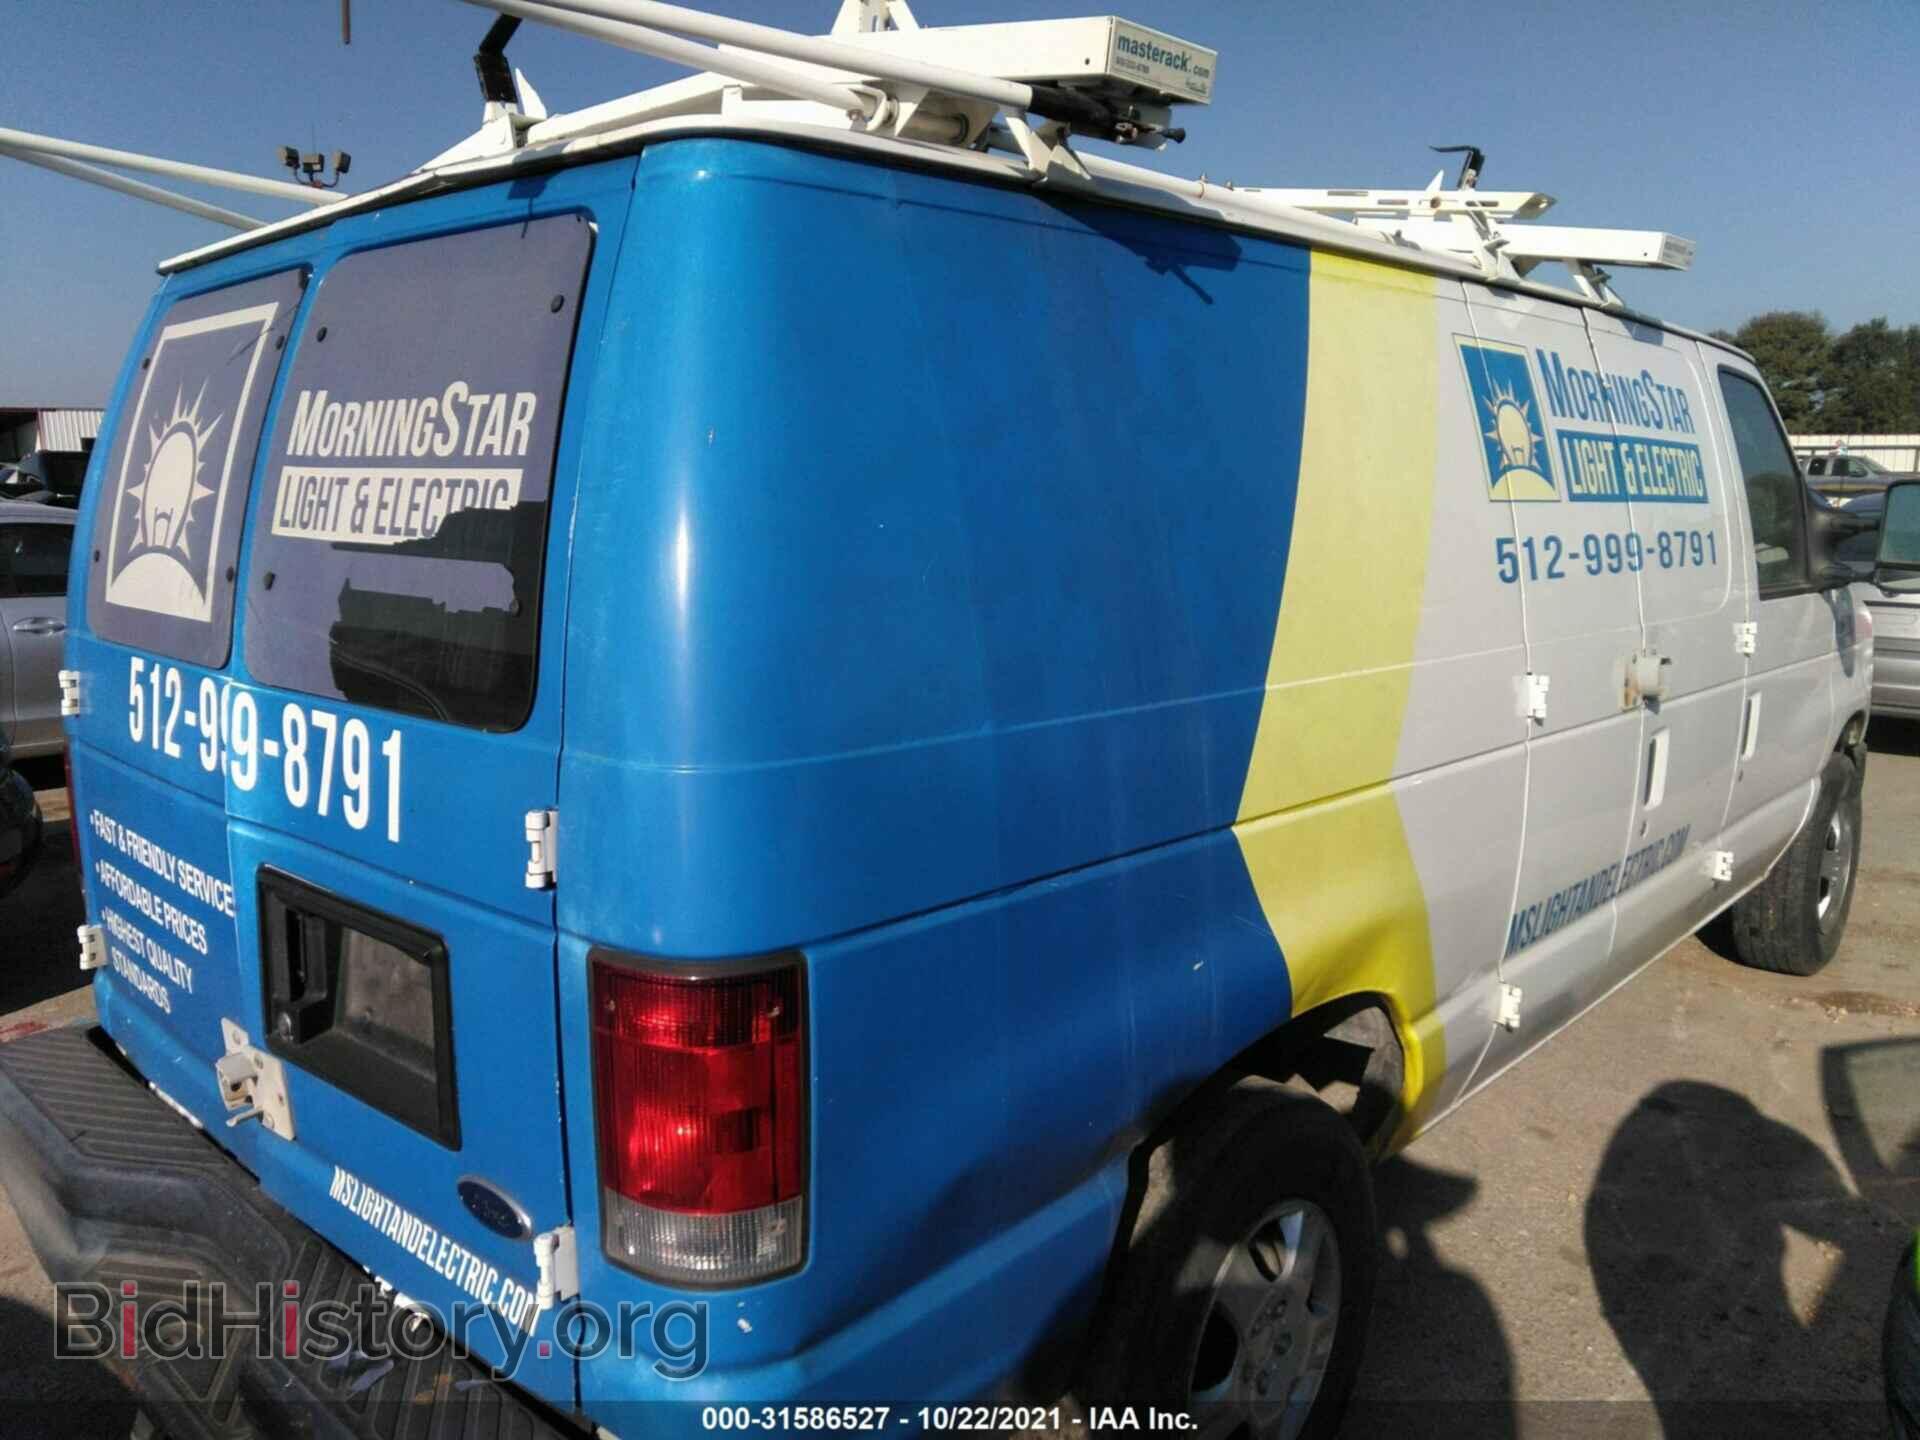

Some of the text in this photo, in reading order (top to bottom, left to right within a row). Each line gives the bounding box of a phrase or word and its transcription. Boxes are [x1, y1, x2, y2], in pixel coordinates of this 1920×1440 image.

[1562, 437, 1704, 497] LIGHT & ELECTRIC
[279, 475, 349, 532] LIGHT
[350, 477, 371, 534] &
[1495, 530, 1717, 584] 512-999-8791
[94, 809, 236, 919] FAST & FRIENDLY SERVICE
[101, 859, 208, 955] AFFORDABLE PRICES
[111, 946, 172, 1014] STANDARDS
[146, 937, 193, 995] QUALITY
